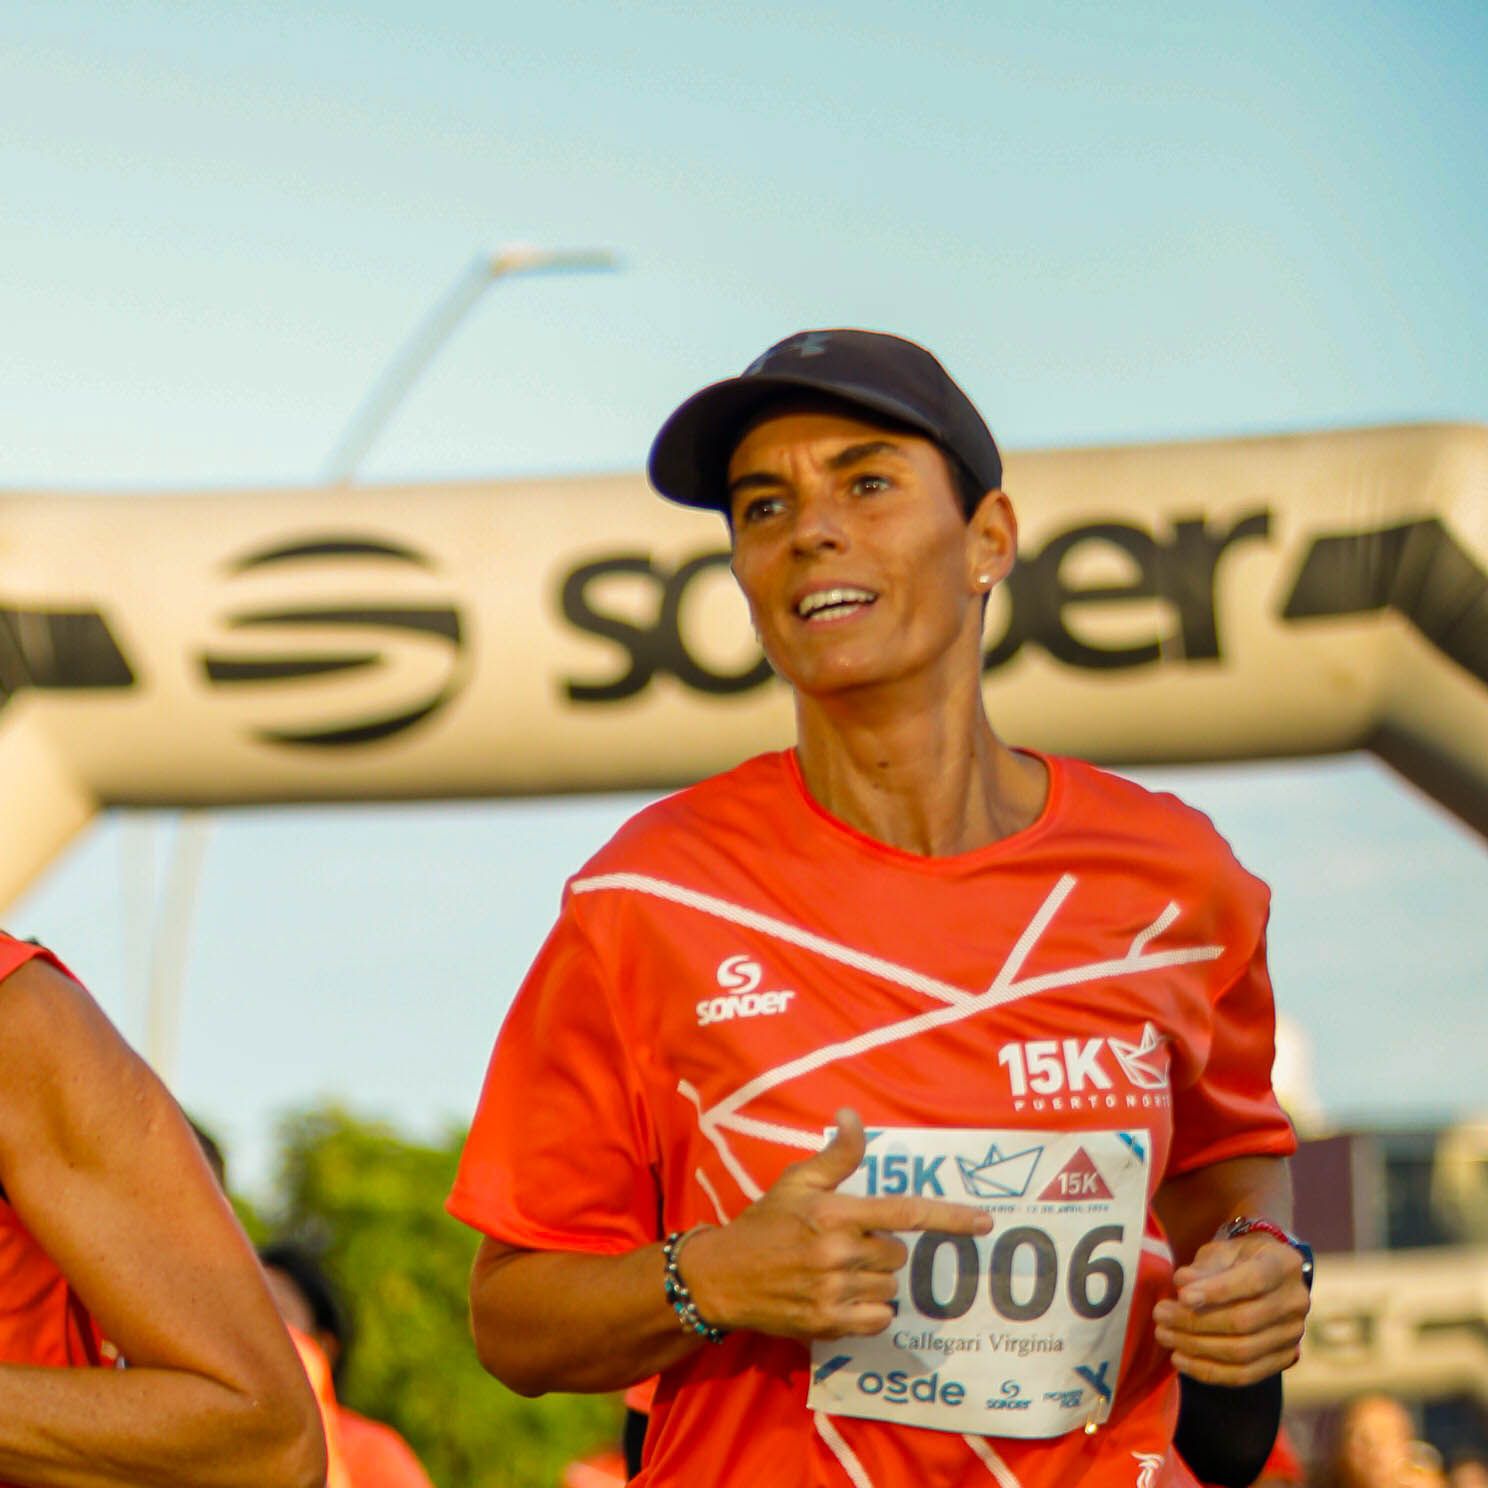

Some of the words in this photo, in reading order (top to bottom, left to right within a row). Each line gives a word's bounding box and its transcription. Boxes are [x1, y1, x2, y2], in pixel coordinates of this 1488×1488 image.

[997, 1037, 1113, 1097] 15K
[1013, 1095, 1117, 1112] PUERTO
[862, 1155, 947, 1197] 15K
[1057, 1172, 1098, 1196] 15K
[885, 1223, 1127, 1322] 006
[893, 1330, 982, 1356] Callegari
[989, 1333, 1065, 1357] Virginia
[856, 1369, 966, 1406] osde
